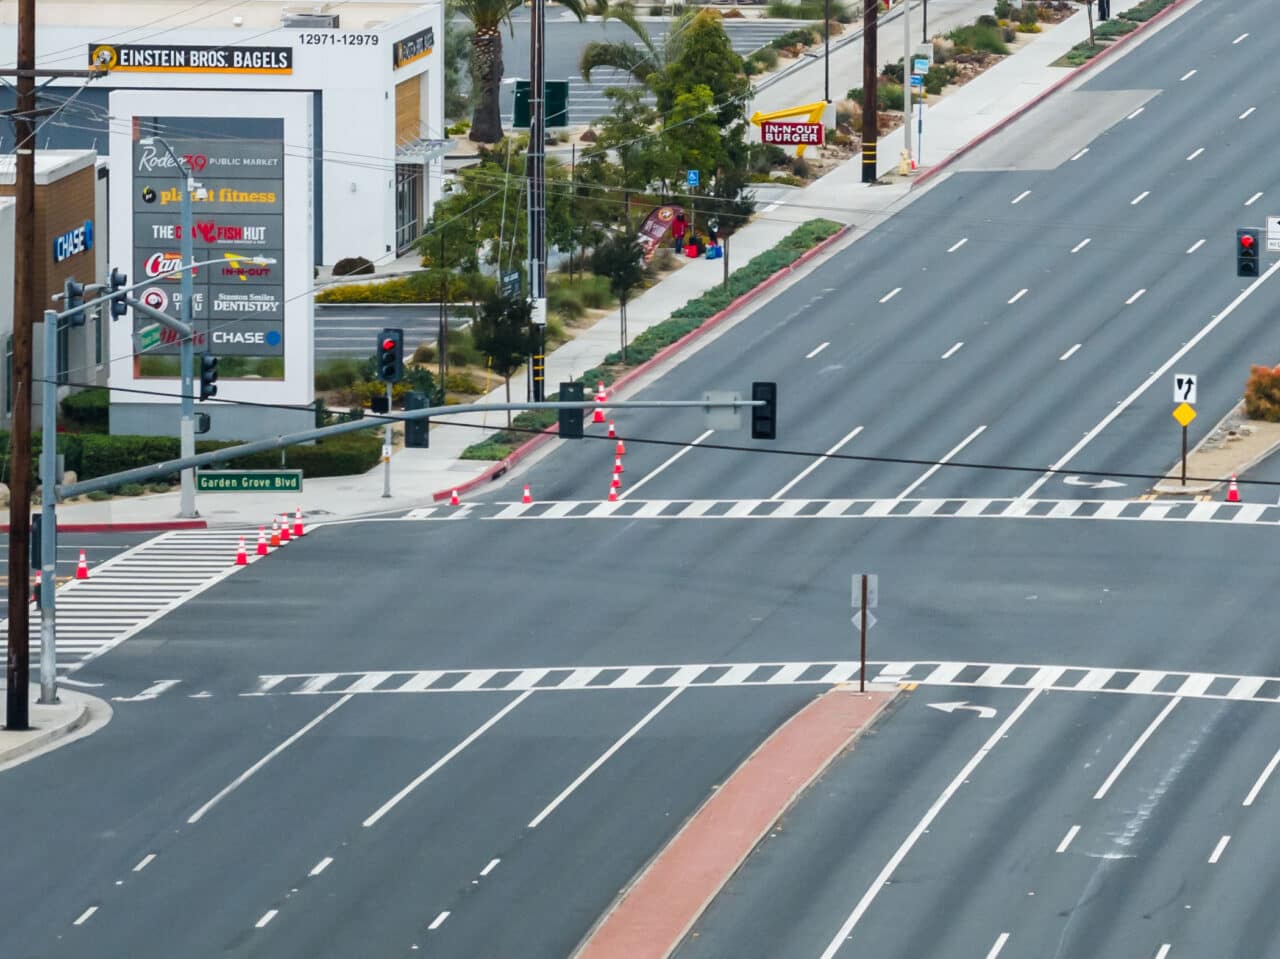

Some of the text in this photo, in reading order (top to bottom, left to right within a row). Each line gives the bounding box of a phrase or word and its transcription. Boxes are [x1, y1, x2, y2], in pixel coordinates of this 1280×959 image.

[299, 33, 379, 46] 12971-12979
[120, 50, 185, 67] EINSTEIN
[233, 52, 289, 69] BAGELS
[765, 124, 819, 134] IN-N-OUT
[765, 133, 818, 143] BURGER
[243, 158, 278, 166] MARKET
[218, 187, 276, 203] fitness
[152, 225, 175, 238] THE
[243, 227, 266, 240] HUT
[57, 225, 86, 261] CHASE
[221, 267, 271, 276] IN-N-OUT
[213, 301, 279, 312] DENTISTRY
[212, 332, 264, 344] CHASE
[201, 477, 297, 488] Garden Grove Blvd
